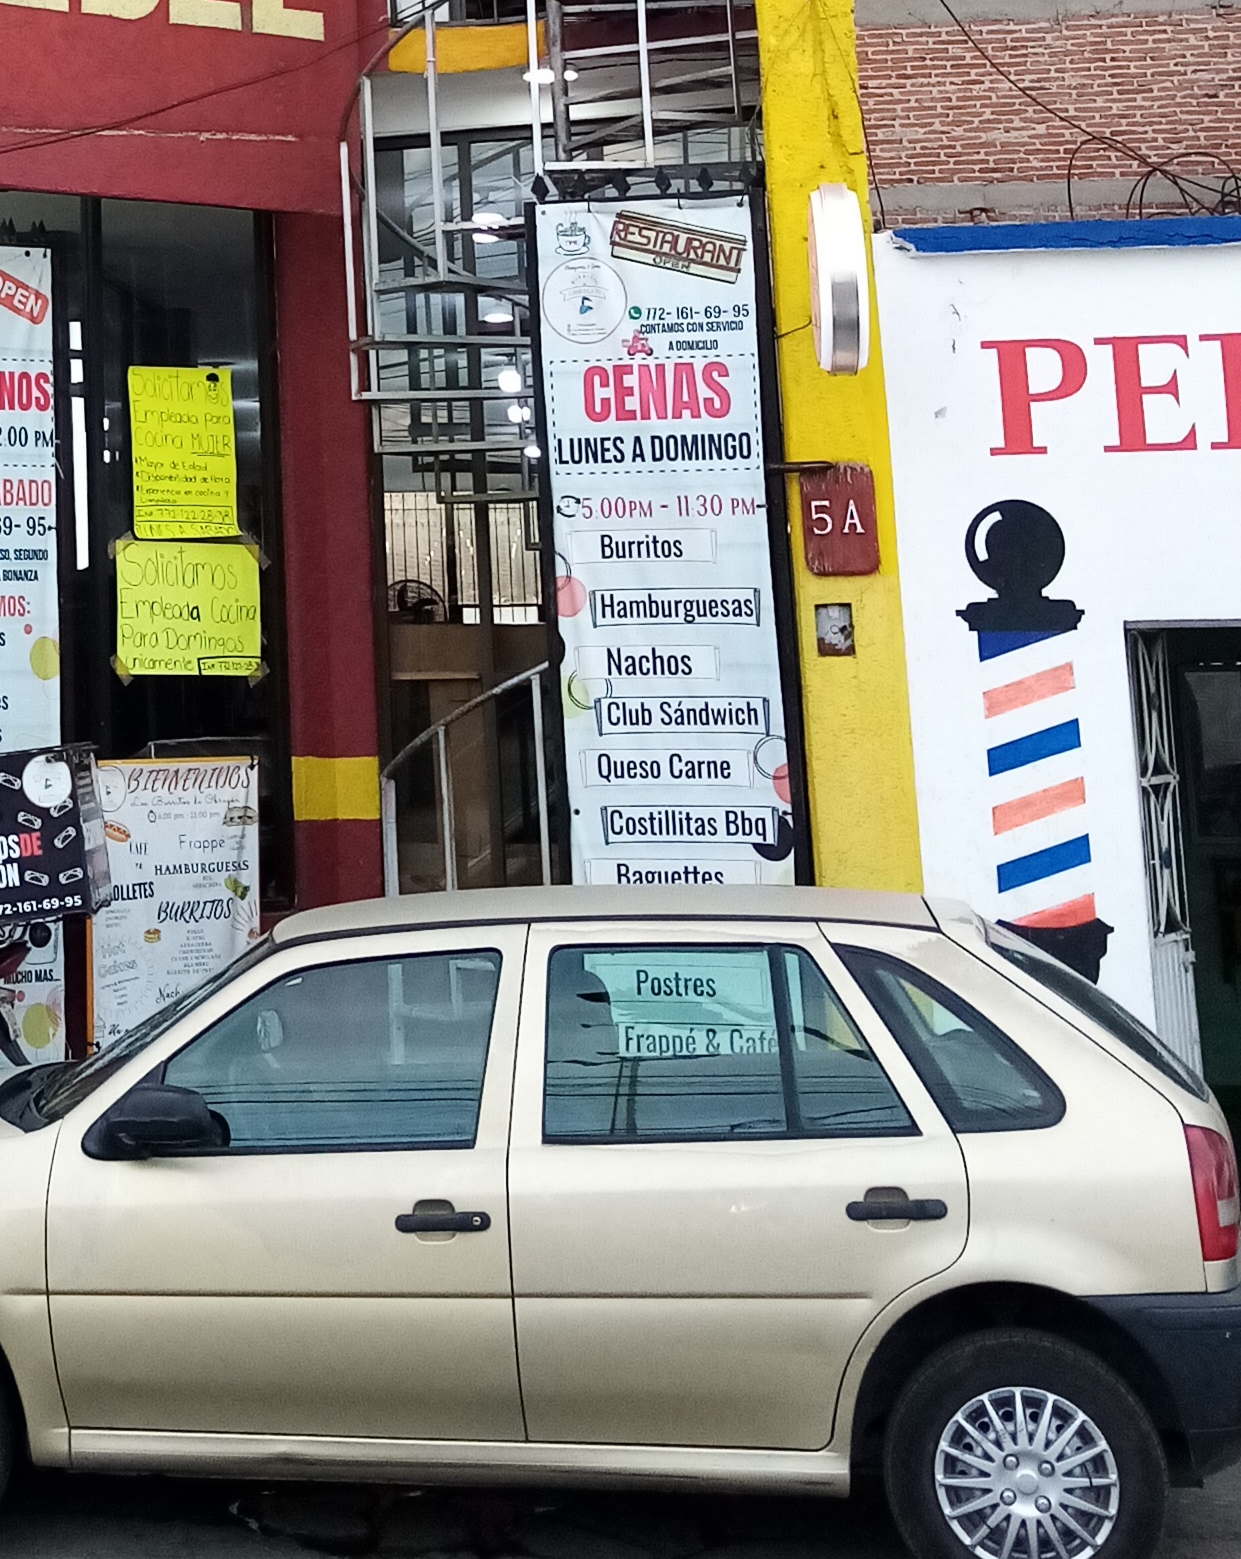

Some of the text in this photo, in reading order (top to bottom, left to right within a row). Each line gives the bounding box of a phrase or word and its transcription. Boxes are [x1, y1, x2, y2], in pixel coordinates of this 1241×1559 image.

[610, 219, 747, 268] RESTAURANT
[653, 255, 691, 271] OPEN
[704, 305, 729, 319] 69-
[732, 304, 750, 318] 95
[640, 320, 744, 335] CONTAMOS CON SERVICIO
[675, 339, 719, 351] DOMICILIO
[583, 361, 731, 423] CENAS
[34, 430, 54, 448] PM
[557, 432, 752, 465] LUNES A DOMINGO
[731, 496, 756, 516] PM
[26, 516, 47, 537] 95
[13, 549, 49, 561] SEGUNDO
[600, 534, 684, 559] Burritos
[2, 569, 39, 581] BONANZA
[120, 541, 238, 591] Solicitamos
[210, 595, 257, 625] Cocina
[600, 593, 755, 623] Hamburguesas
[606, 646, 693, 676] Nachos
[607, 699, 759, 727] Club Sándwich
[596, 753, 732, 781] Queso Carne
[609, 809, 768, 843] Costillitas Bbq
[19, 831, 43, 857] DE
[154, 860, 250, 876] HAMBURGUESAS
[111, 881, 155, 902] OLLETES
[157, 897, 234, 924] BURRITOS
[635, 969, 717, 998] Postres
[624, 1025, 778, 1056] Frappé & Café
